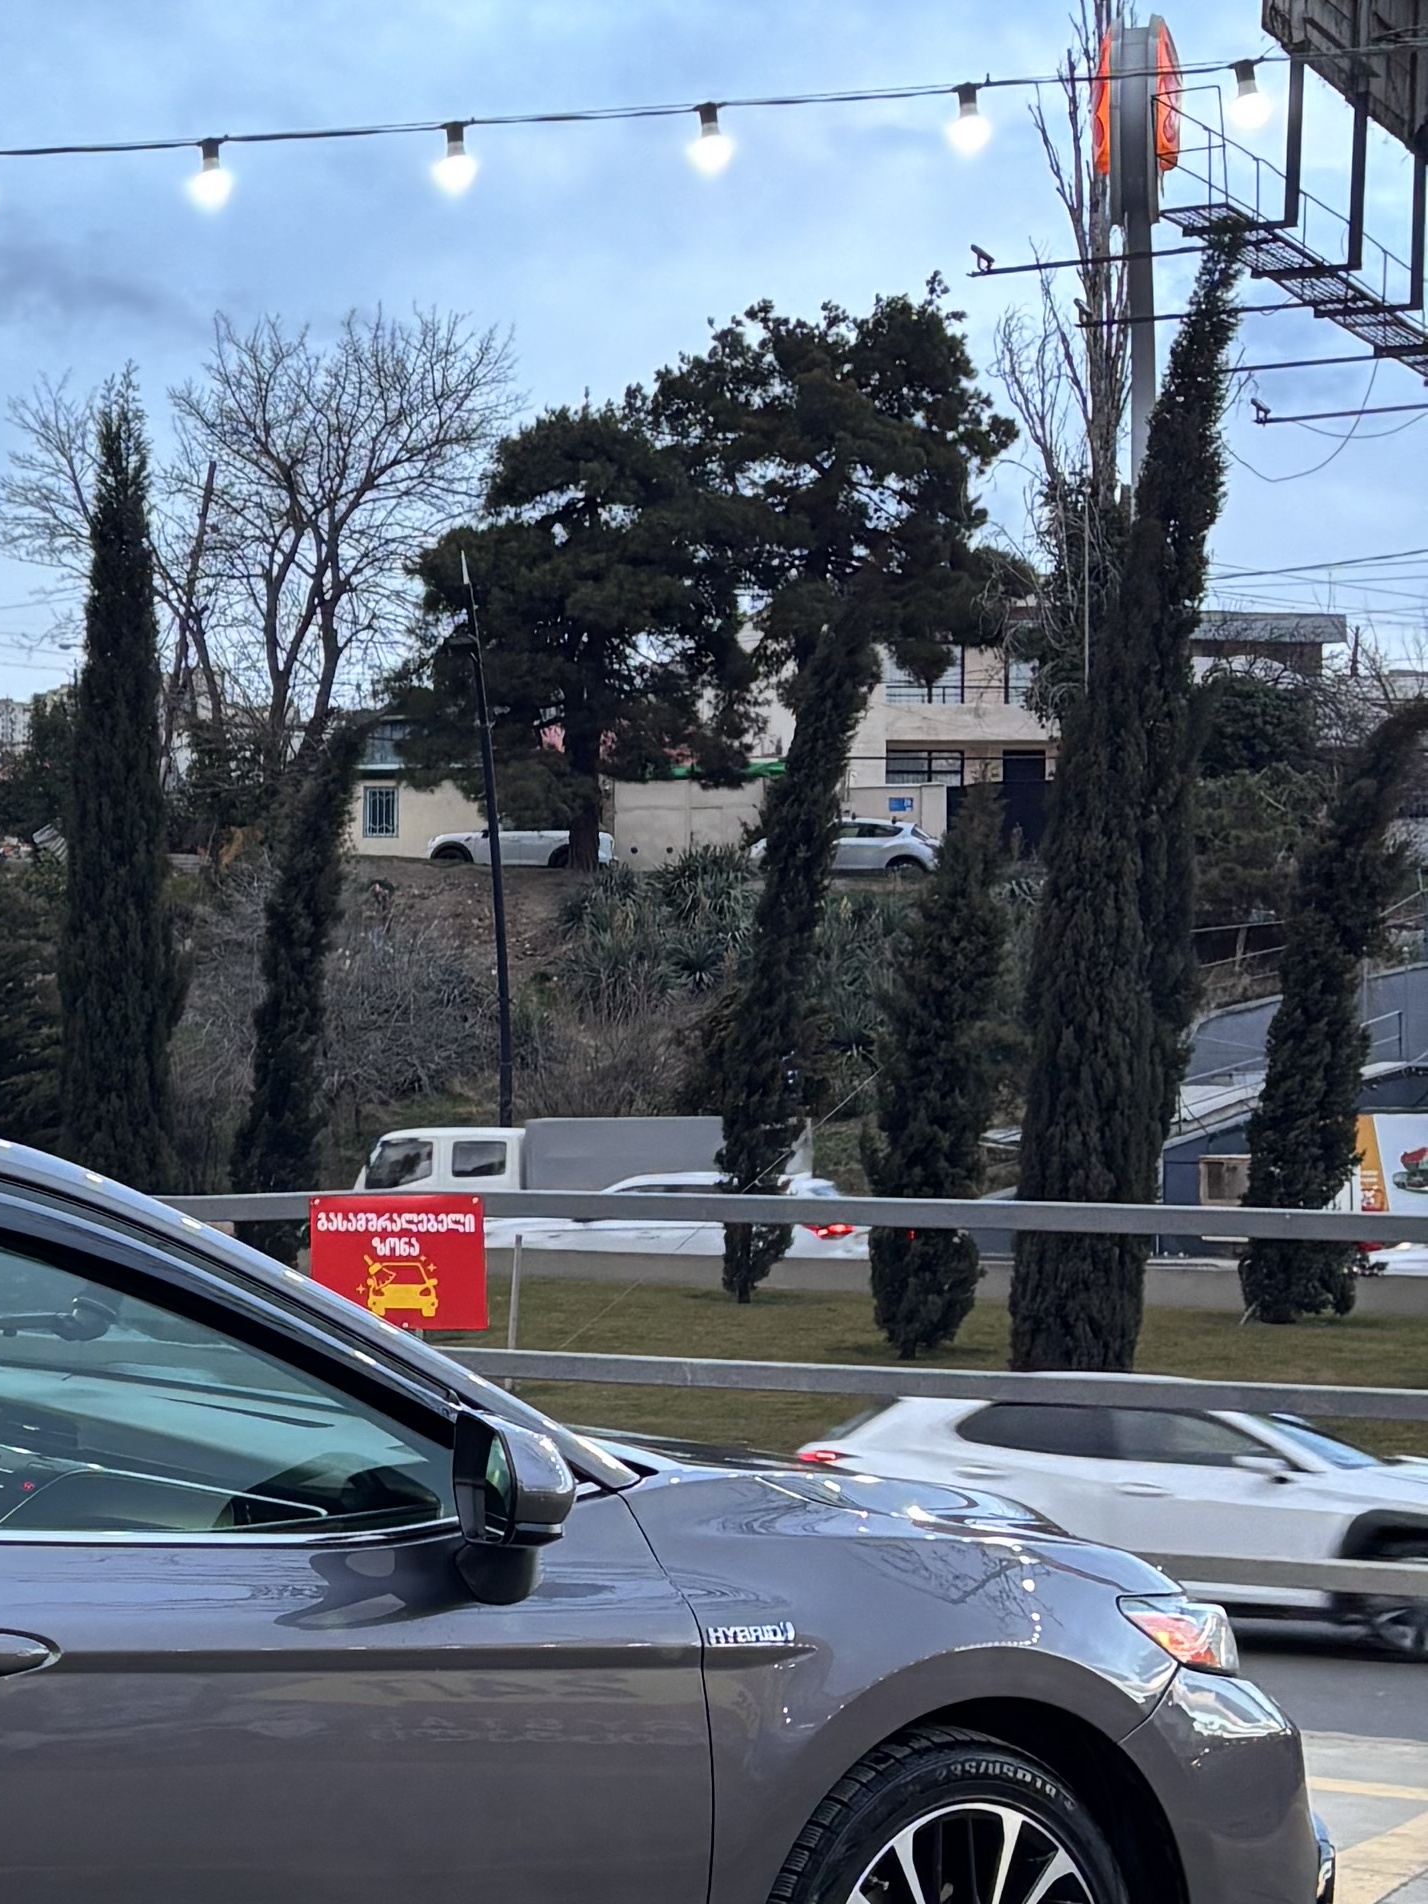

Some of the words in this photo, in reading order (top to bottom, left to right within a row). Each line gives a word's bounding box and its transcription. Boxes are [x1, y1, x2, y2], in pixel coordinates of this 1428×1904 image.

[317, 1211, 476, 1233] გასამშრალებელი
[371, 1236, 420, 1257] ზონა
[707, 1624, 784, 1645] HYBRID
